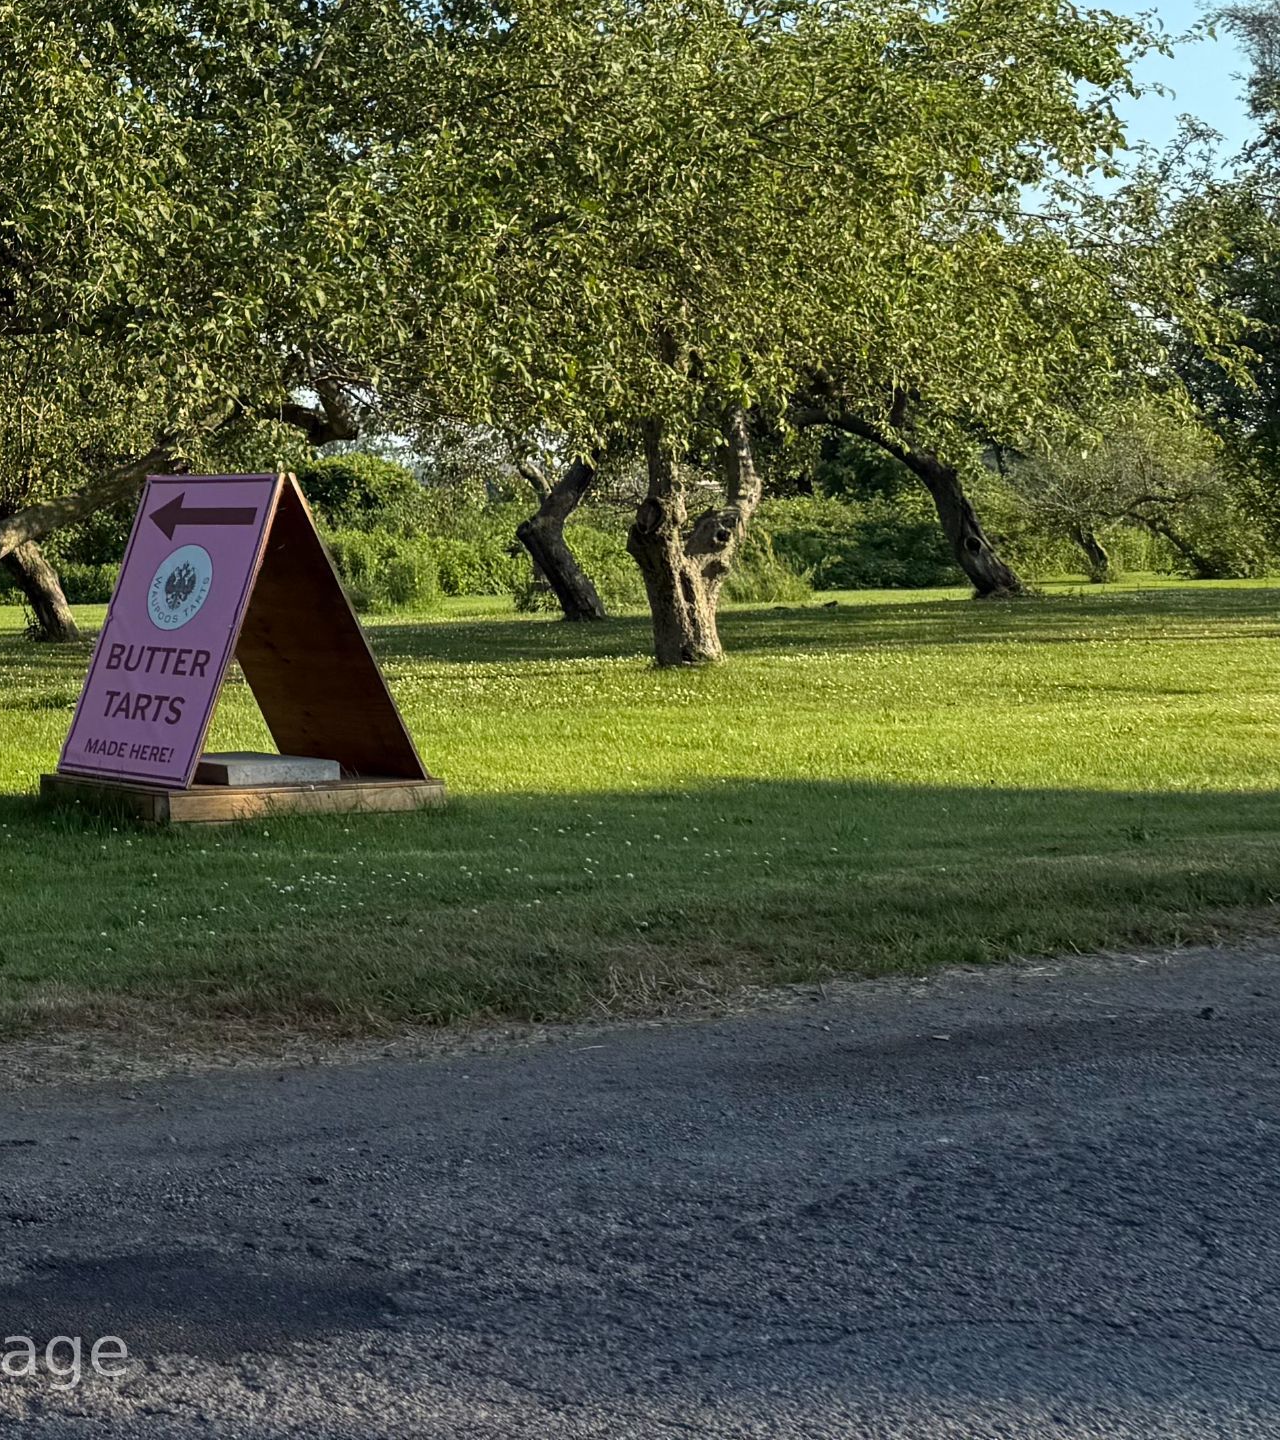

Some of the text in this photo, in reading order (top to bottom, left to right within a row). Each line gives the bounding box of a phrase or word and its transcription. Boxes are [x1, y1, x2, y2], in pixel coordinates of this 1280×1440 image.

[151, 576, 179, 623] WAUPOOS
[105, 643, 211, 678] BUTTER
[103, 690, 186, 725] TARTS
[84, 738, 175, 763] MADE HERE!
